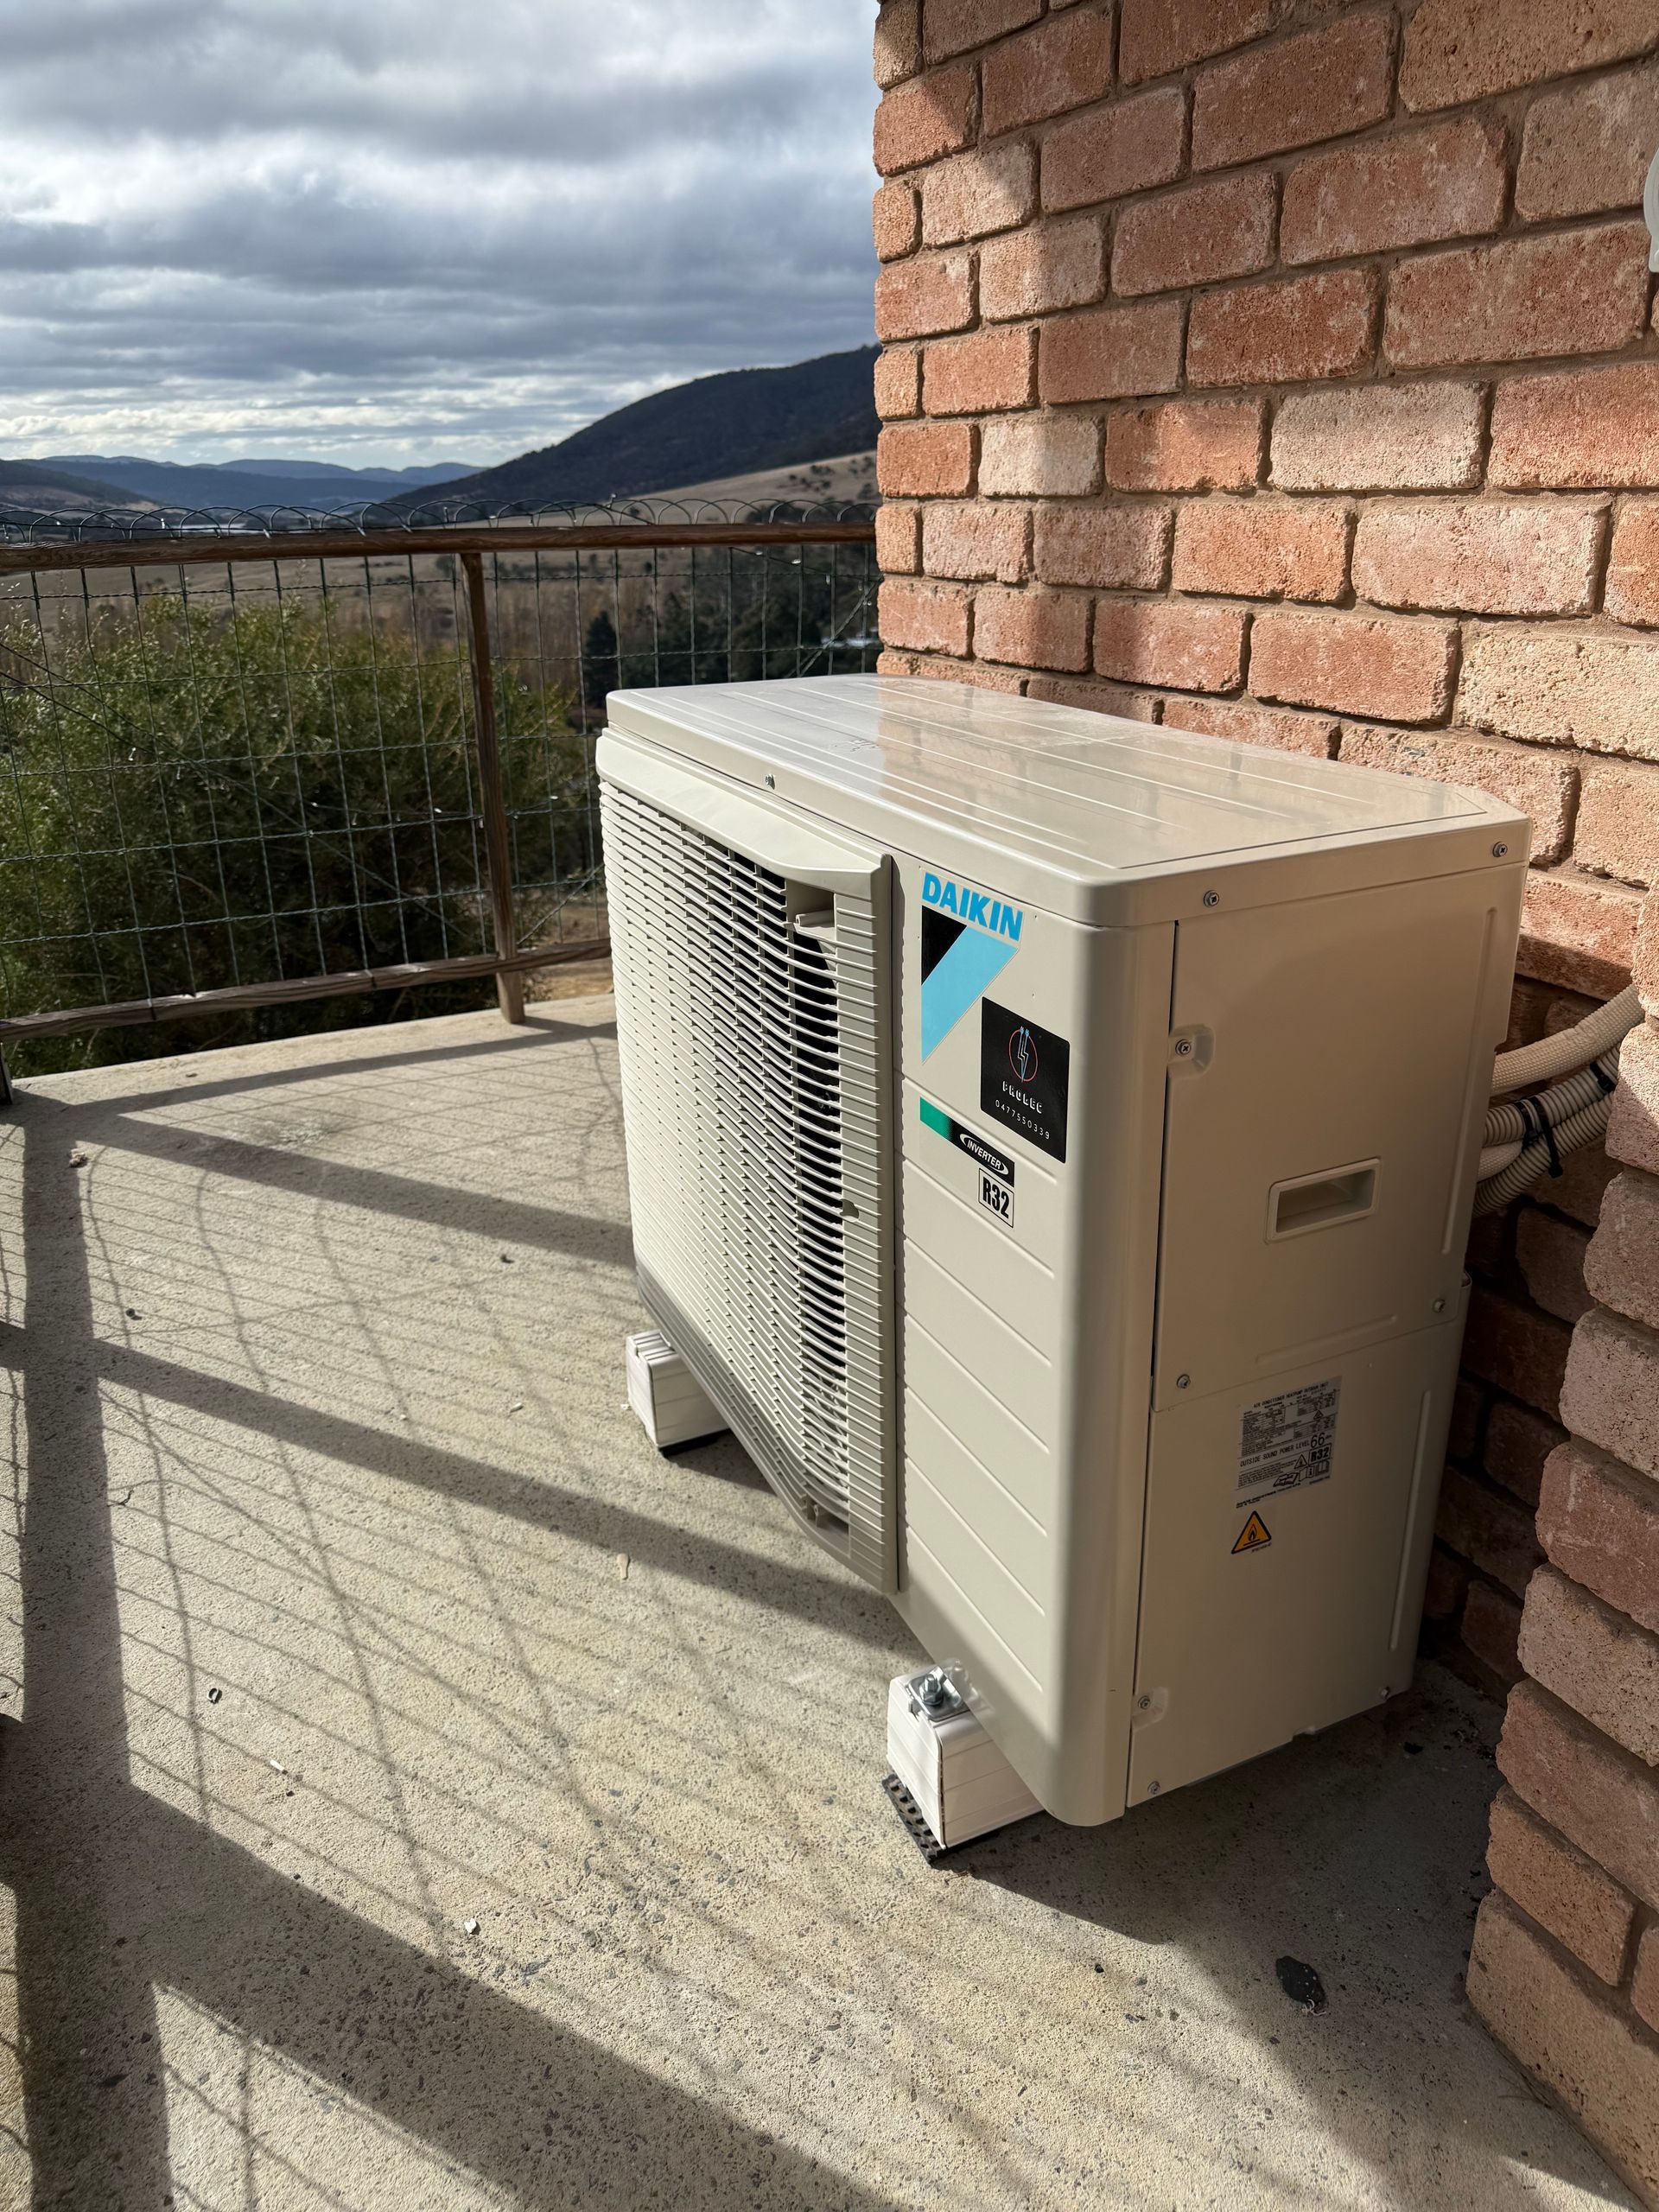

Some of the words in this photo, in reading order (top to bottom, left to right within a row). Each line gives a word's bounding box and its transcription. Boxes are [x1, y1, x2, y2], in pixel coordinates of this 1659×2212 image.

[922, 872, 1023, 942] DAIKIN
[1002, 1080, 1043, 1114] PROLEC
[995, 1099, 1050, 1140] 0477550339
[967, 1139, 1001, 1170] INVERTER
[982, 1176, 1009, 1219] R32
[1240, 1455, 1261, 1467] OUTSIDE
[1262, 1450, 1277, 1460] SOUND
[1280, 1445, 1294, 1454] POWER
[1295, 1440, 1309, 1449] LEVEL
[1310, 1432, 1325, 1448] 66
[1311, 1446, 1329, 1462] R32
